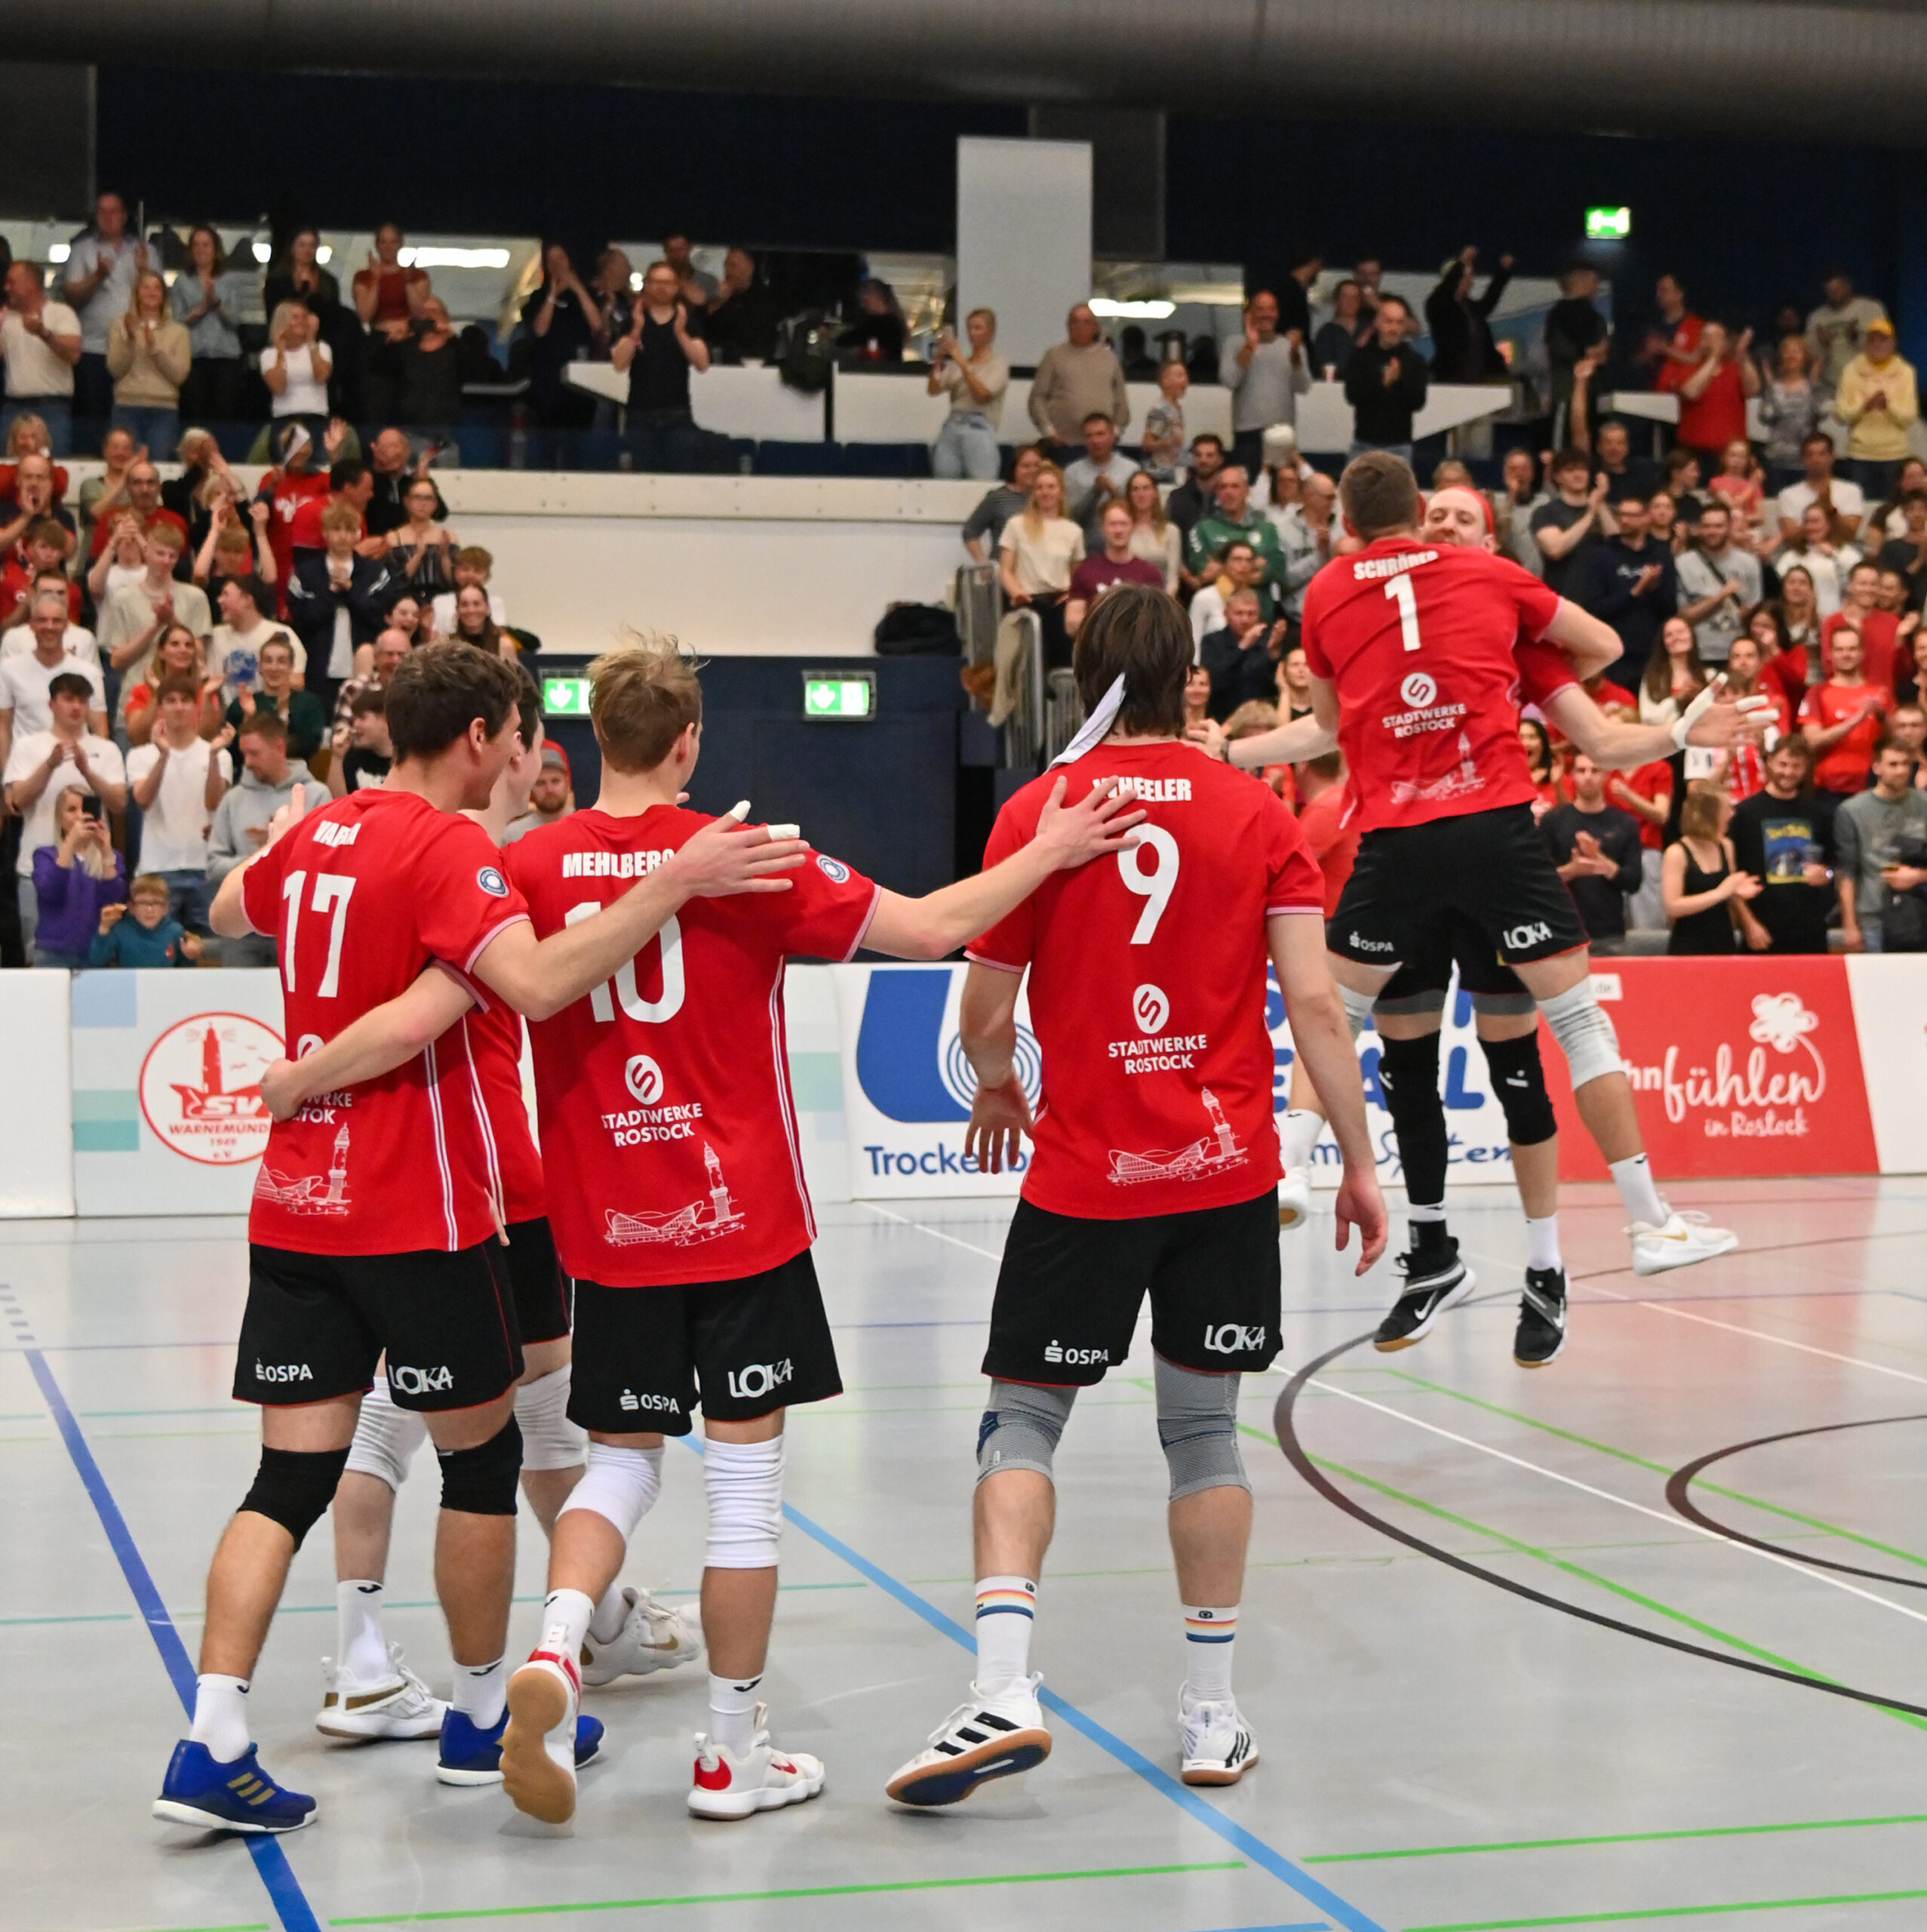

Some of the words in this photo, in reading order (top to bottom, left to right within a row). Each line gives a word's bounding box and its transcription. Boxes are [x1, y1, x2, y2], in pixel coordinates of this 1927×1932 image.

[1384, 573, 1421, 652] 1
[1382, 703, 1467, 728] STADTWERKE
[1394, 716, 1456, 738] ROSTOCK
[1117, 822, 1180, 945] 9
[282, 869, 357, 998] 17
[1360, 939, 1394, 952] OSPA
[1502, 921, 1554, 949] LOKA
[564, 900, 686, 1024] 10
[1108, 1034, 1208, 1058] STADTWERKE
[1124, 1054, 1195, 1075] ROSTOCK
[1624, 1041, 1824, 1124] hnfühlen
[169, 1121, 269, 1134] WARNEMÜND
[601, 1102, 704, 1130] STADTWERKE
[1704, 1116, 1729, 1137] in
[1731, 1106, 1810, 1138] Rostock
[613, 1121, 696, 1147] ROSTOCK
[1204, 1323, 1267, 1354] LOKA
[1065, 1348, 1109, 1365] OSPA
[265, 1362, 314, 1383] OSPA
[388, 1364, 454, 1395] LOKA
[727, 1357, 794, 1398] LOKA
[641, 1393, 681, 1414] OSPA
